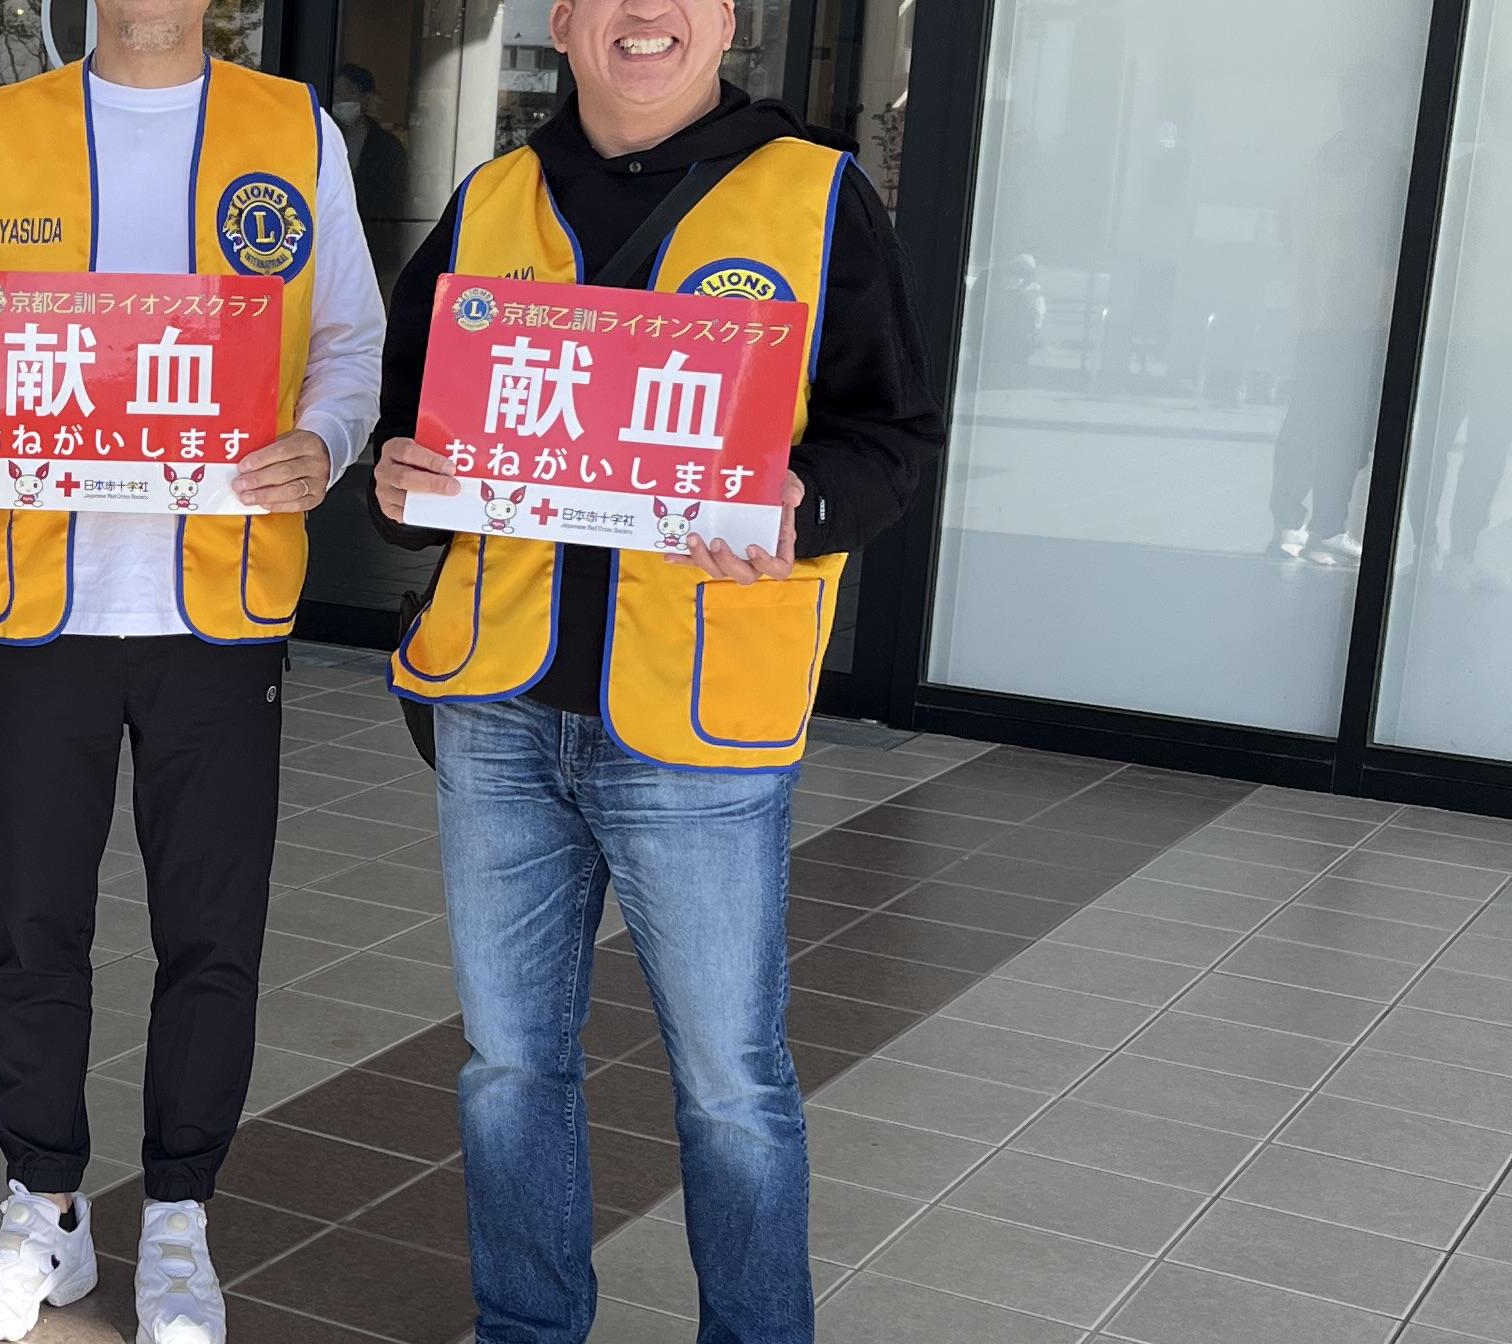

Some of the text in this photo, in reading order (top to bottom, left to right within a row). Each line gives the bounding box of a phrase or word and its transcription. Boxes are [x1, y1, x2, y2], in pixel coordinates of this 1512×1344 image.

[236, 185, 285, 206] LIONS
[253, 211, 276, 244] L
[705, 272, 771, 296] LIONS
[10, 290, 272, 318] 京都乙訓ライオンズクラブ
[469, 300, 482, 318] L
[500, 302, 791, 347] 京都乙訓ライオンズクラブ
[4, 322, 221, 417] 献血
[483, 336, 724, 450] 献血
[445, 439, 755, 498] おねがいします
